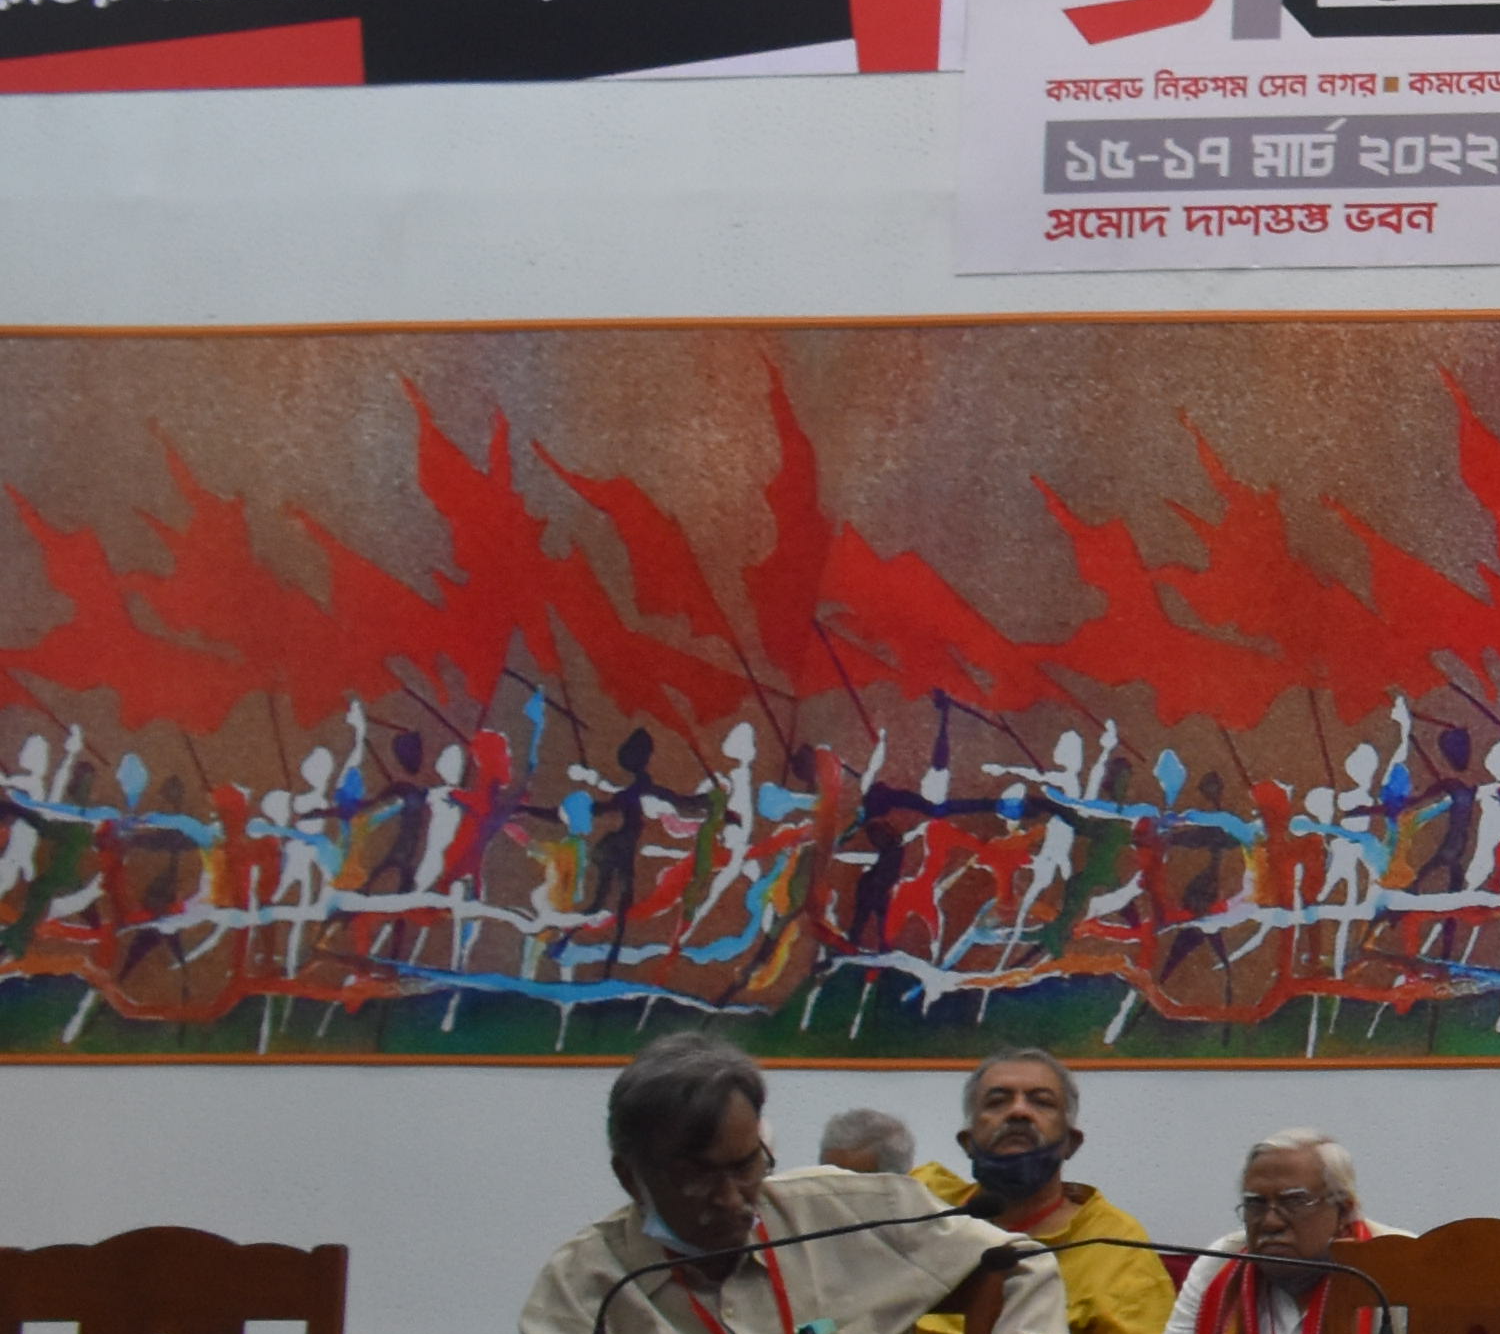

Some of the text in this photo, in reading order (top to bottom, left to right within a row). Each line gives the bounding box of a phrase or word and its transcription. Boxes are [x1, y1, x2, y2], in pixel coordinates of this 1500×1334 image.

[1046, 78, 1143, 102] কমরেড
[1155, 69, 1247, 100] নিরুপম
[1259, 74, 1307, 97] সেন
[1318, 73, 1377, 97] নগর
[1065, 136, 1230, 181] ১৫-১৭
[1252, 118, 1347, 178] মার্চ
[1359, 133, 1499, 177] ২০২২
[1045, 206, 1170, 241] প্রমোদ
[1345, 202, 1437, 235] ভবন
